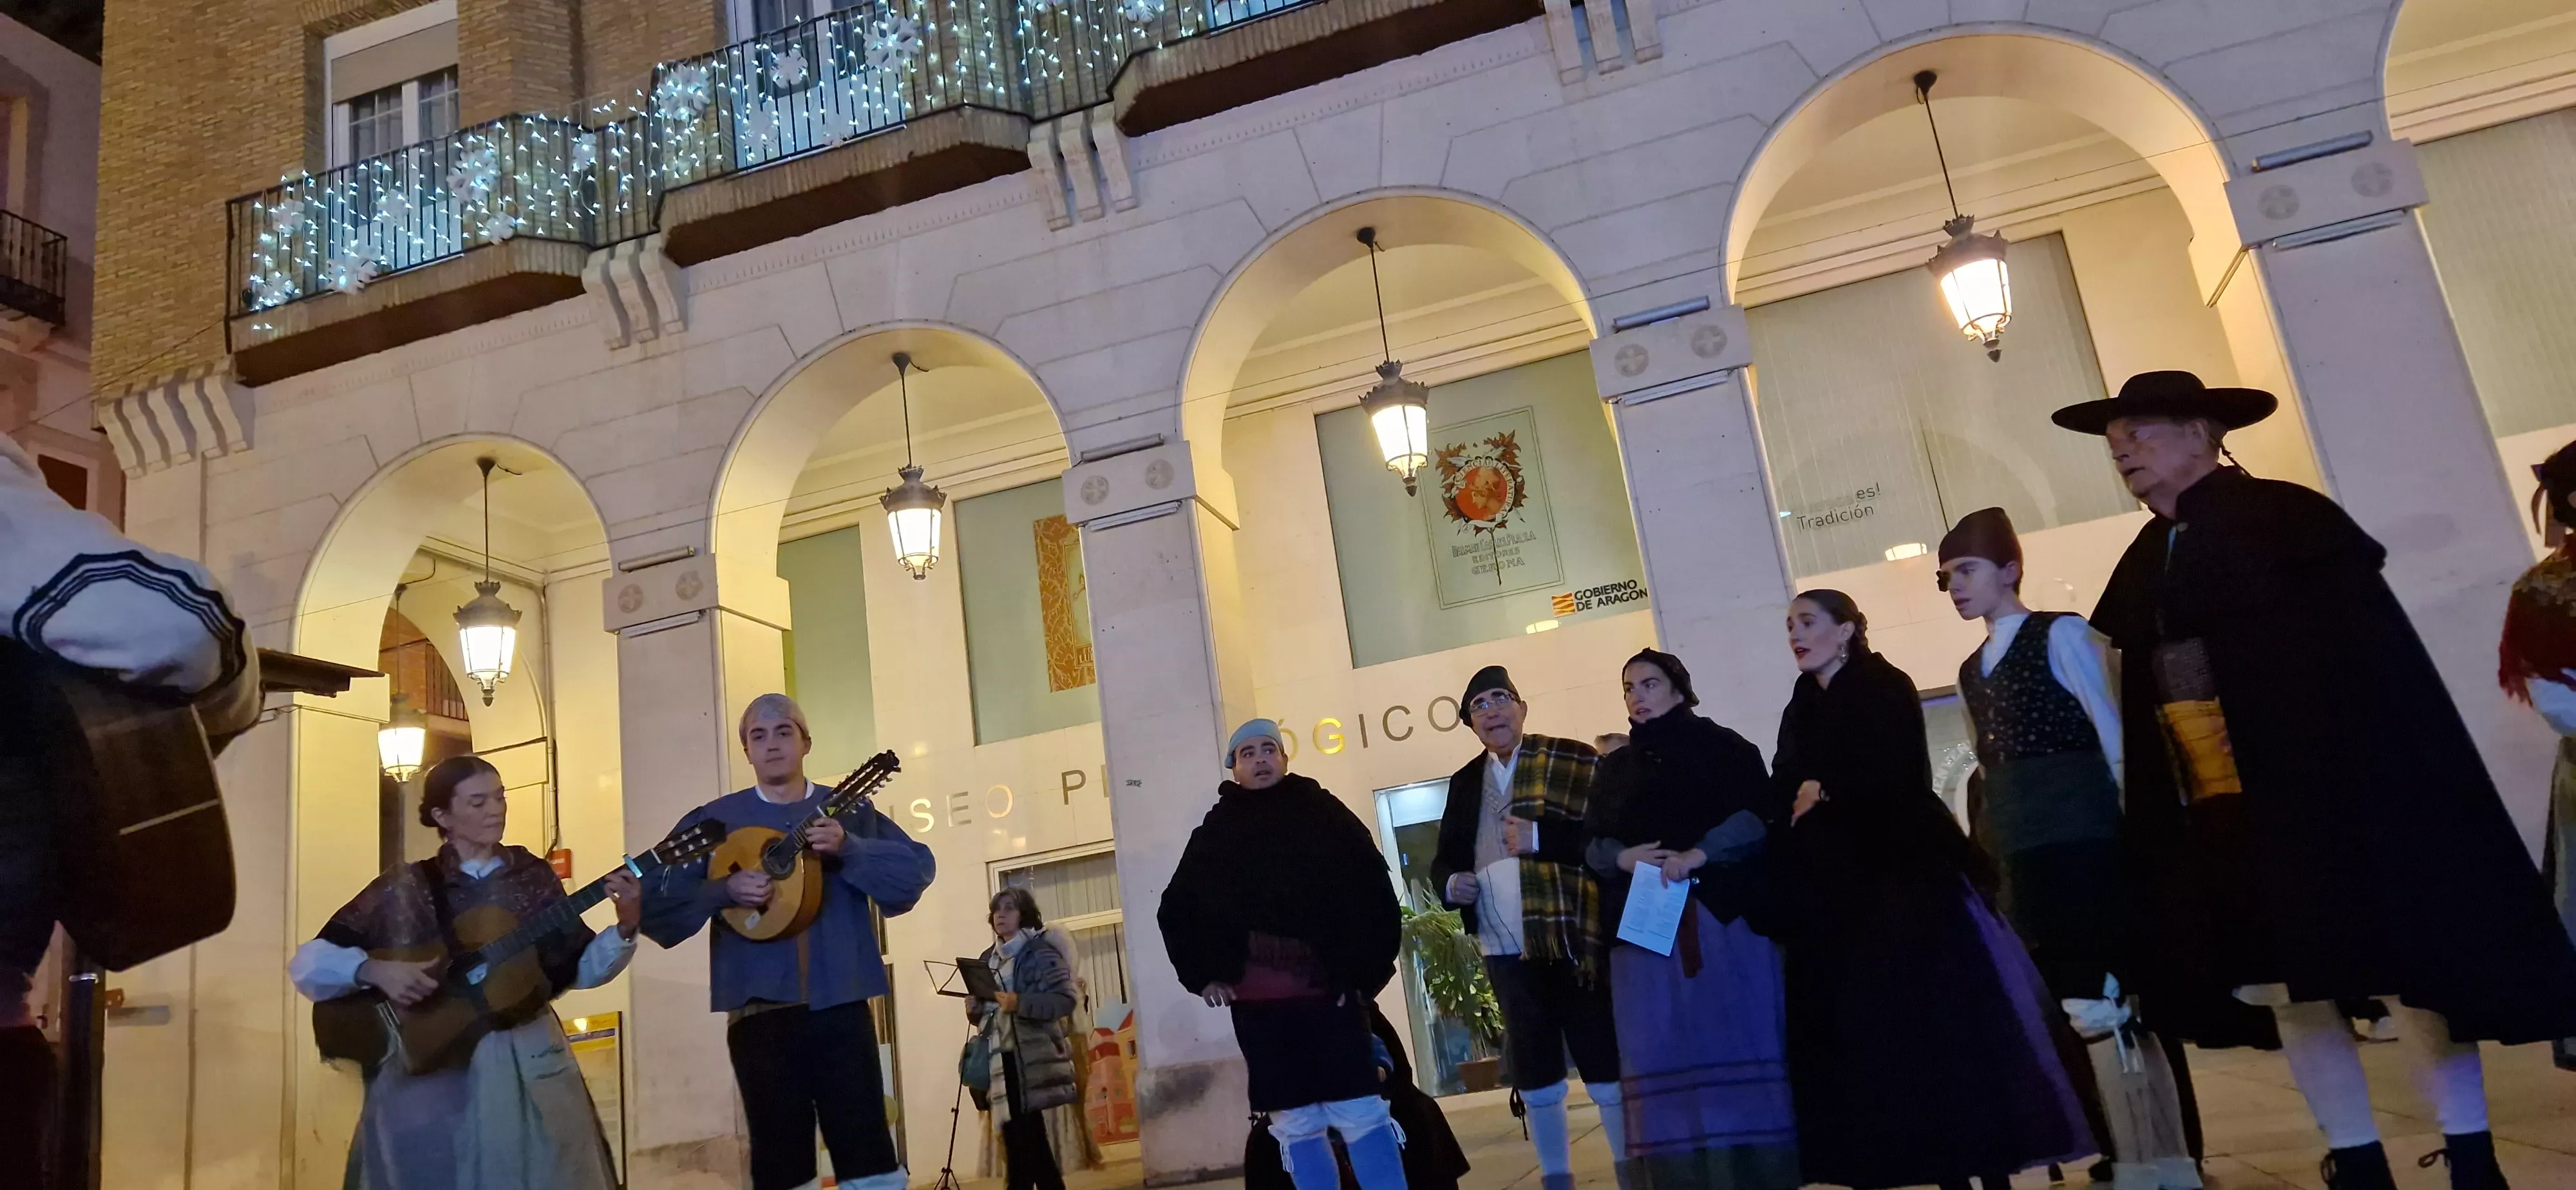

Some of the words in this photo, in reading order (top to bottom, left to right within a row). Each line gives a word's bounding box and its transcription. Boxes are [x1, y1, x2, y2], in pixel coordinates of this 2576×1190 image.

[1856, 482, 1881, 500] es!
[1797, 504, 1874, 530] Tradición
[1574, 579, 1638, 601] GOBIERNO
[1576, 600, 1593, 612] DE
